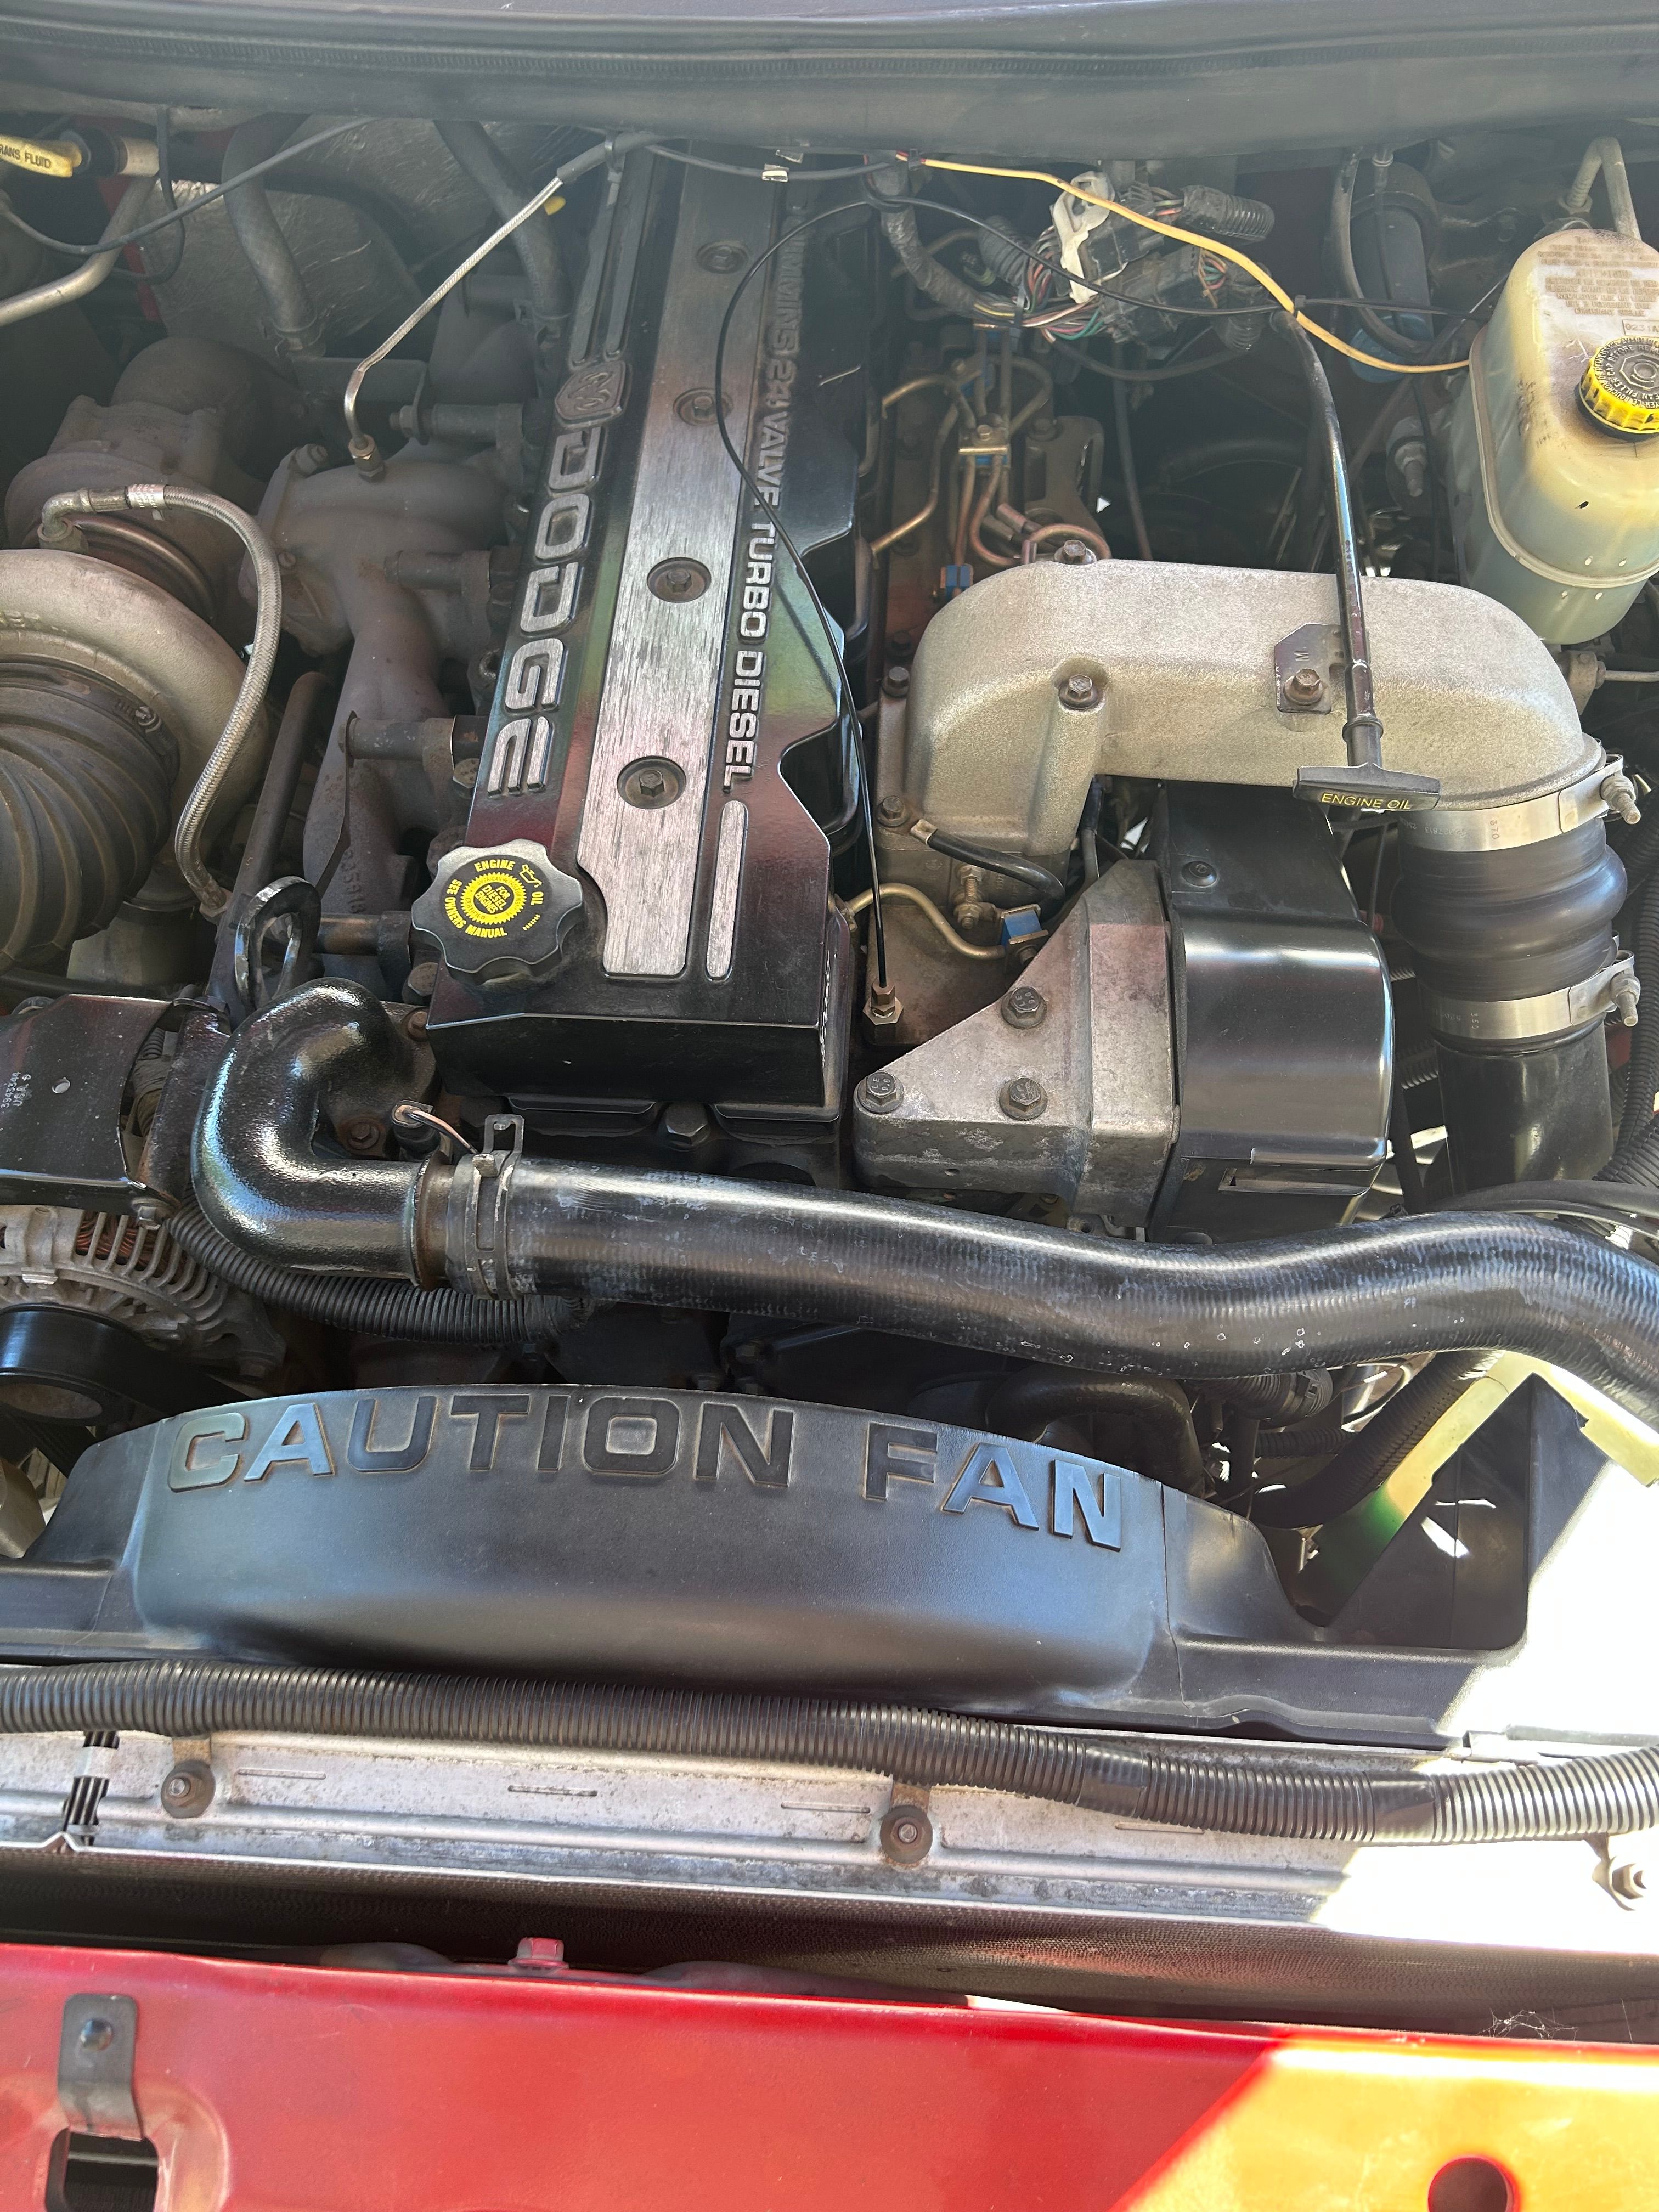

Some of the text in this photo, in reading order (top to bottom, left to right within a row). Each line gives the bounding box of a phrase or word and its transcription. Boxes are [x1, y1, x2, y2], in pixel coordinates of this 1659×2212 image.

[25, 151, 52, 168] FLUID
[1607, 344, 1635, 362] BEFORE
[1606, 363, 1616, 376] CAP
[768, 359, 795, 407] 24
[1611, 377, 1638, 397] FILLER
[754, 411, 788, 506] VALVE
[740, 521, 776, 637] TURBO
[488, 427, 601, 795] DODGE
[724, 651, 763, 787] DIESEL
[1322, 793, 1411, 809] ENGINE OIL
[474, 859, 544, 906] ENGINE OIL
[496, 886, 511, 899] FOR
[447, 879, 462, 895] SEE
[465, 924, 508, 938] MANUAL
[465, 897, 486, 920] CERTIFIED
[475, 891, 499, 913] ENGINES
[482, 885, 506, 910] DIESEL
[167, 1394, 1122, 1552] CAUTION FAN
